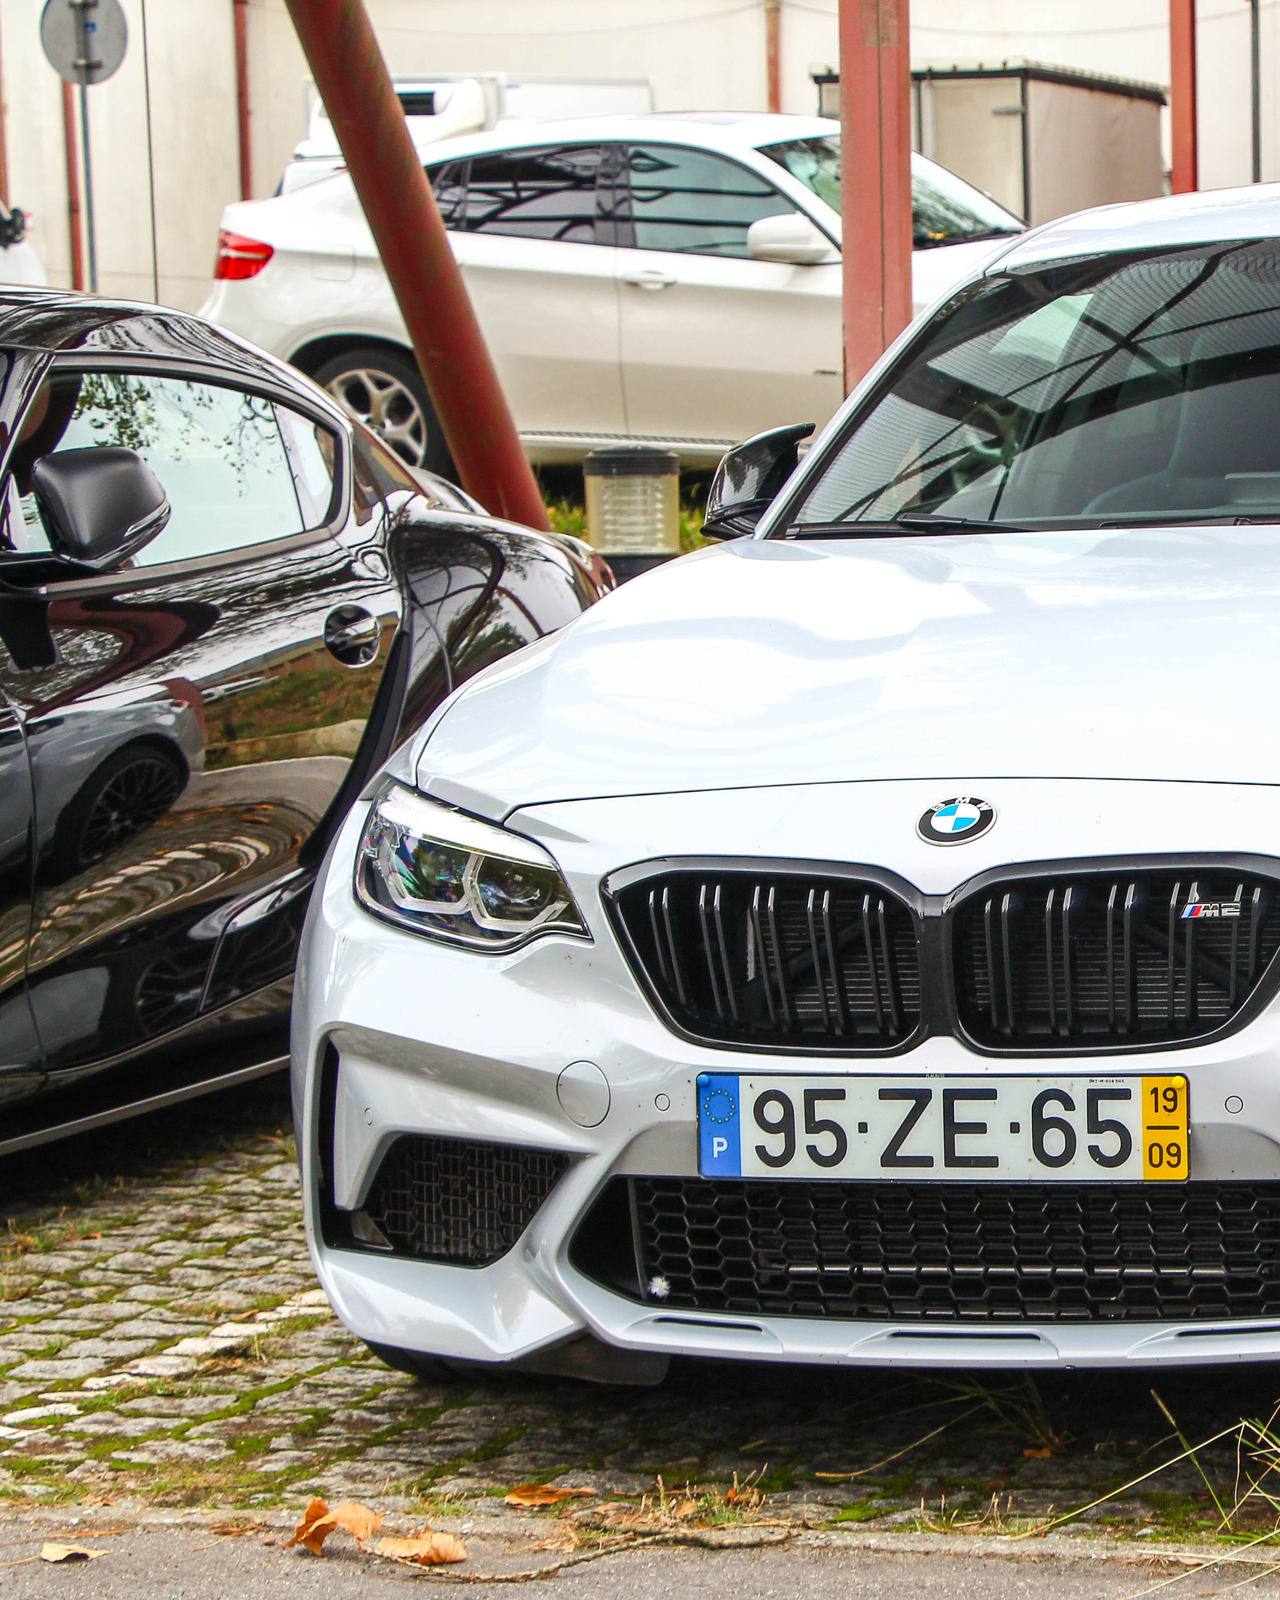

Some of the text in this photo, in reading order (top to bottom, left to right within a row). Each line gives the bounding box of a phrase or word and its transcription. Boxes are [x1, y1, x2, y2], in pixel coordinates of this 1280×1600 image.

[930, 797, 992, 811] BMW
[1198, 903, 1241, 917] M2
[1150, 1087, 1179, 1113] 19
[712, 1136, 729, 1158] P
[1147, 1142, 1182, 1168] 09
